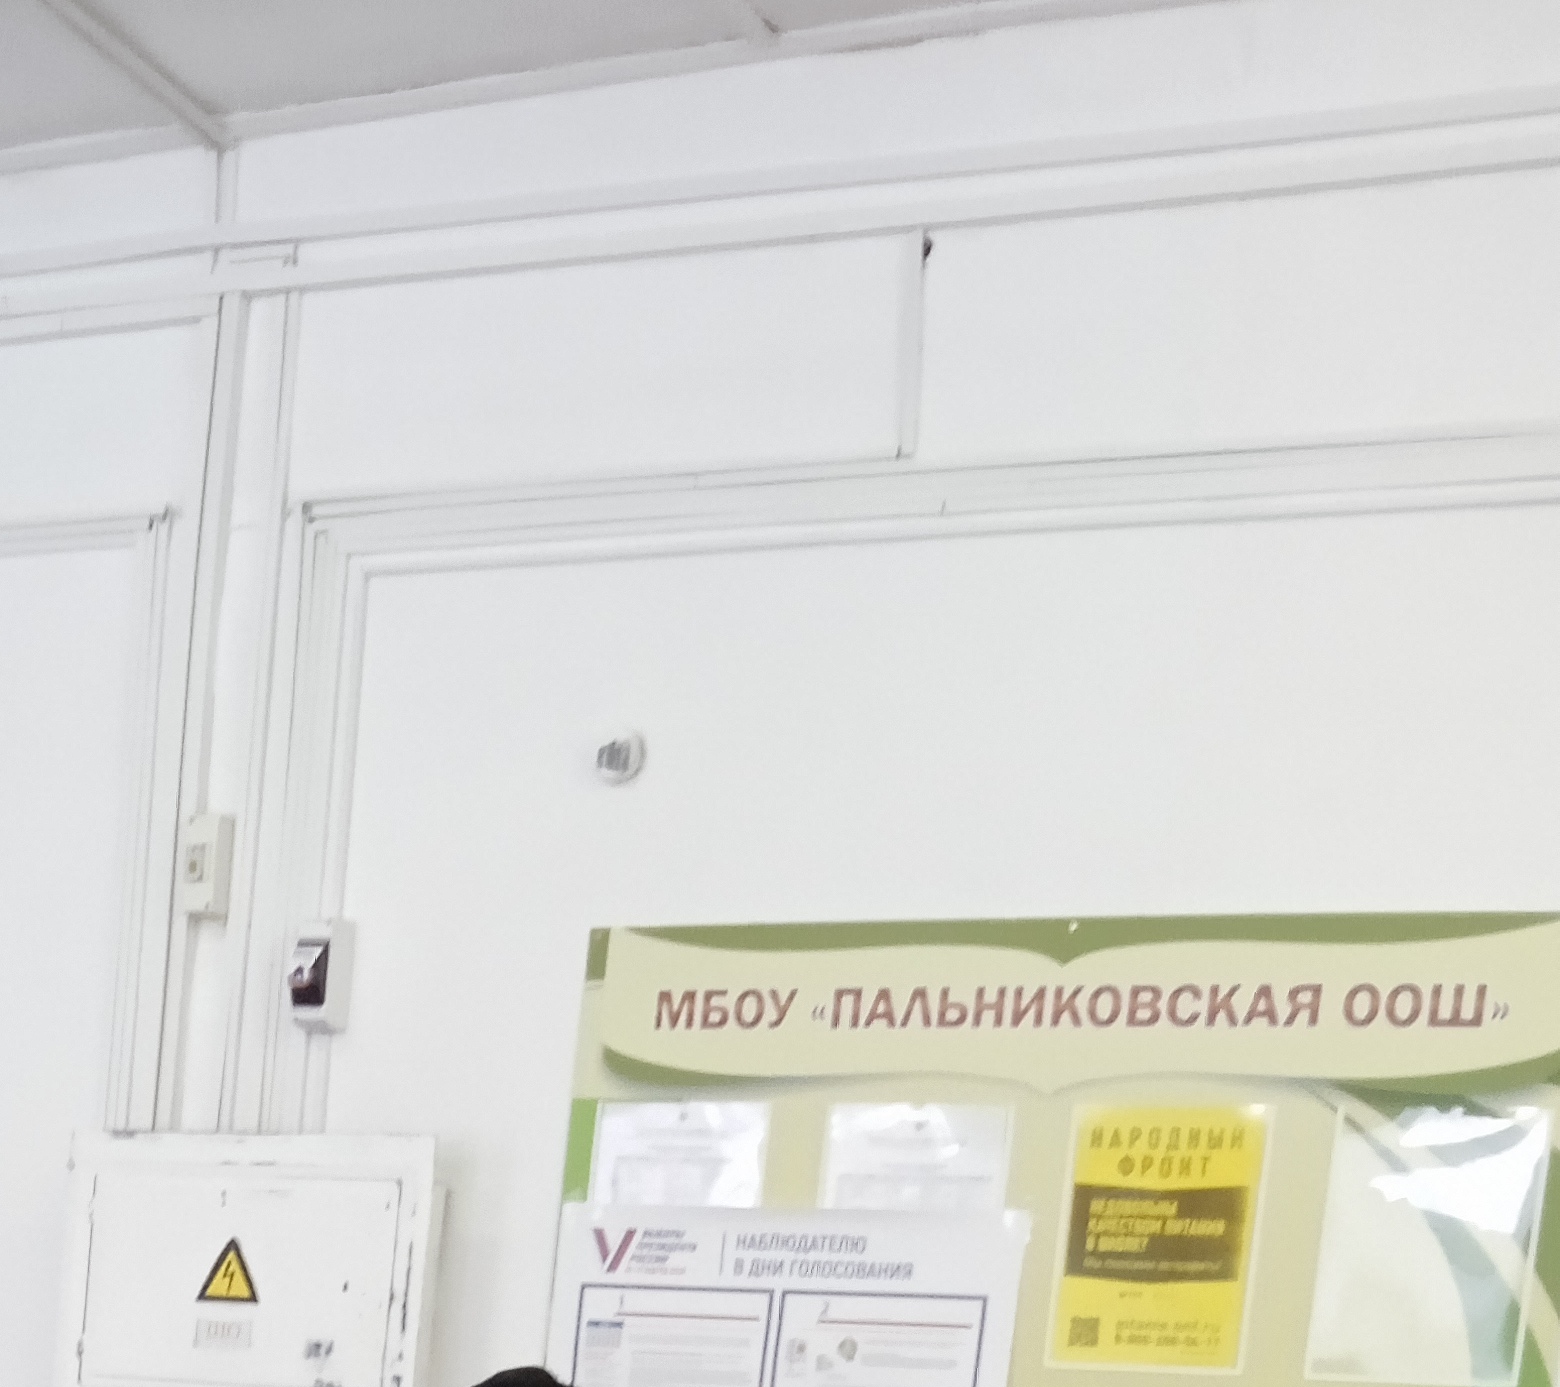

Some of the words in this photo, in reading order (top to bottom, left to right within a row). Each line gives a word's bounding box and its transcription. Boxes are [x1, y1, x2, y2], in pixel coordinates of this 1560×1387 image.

[653, 988, 798, 1032] МБОУ
[811, 984, 1324, 1031] «ПАЛЬНИКОВСКАЯ
[1342, 981, 1511, 1029] ООШ»
[735, 1232, 867, 1255] НАБЛЮДАТЕЛЮ
[733, 1258, 743, 1276] В
[748, 1259, 786, 1279] ДНИ
[789, 1260, 914, 1281] ГОЛОСОВАНИЯ
